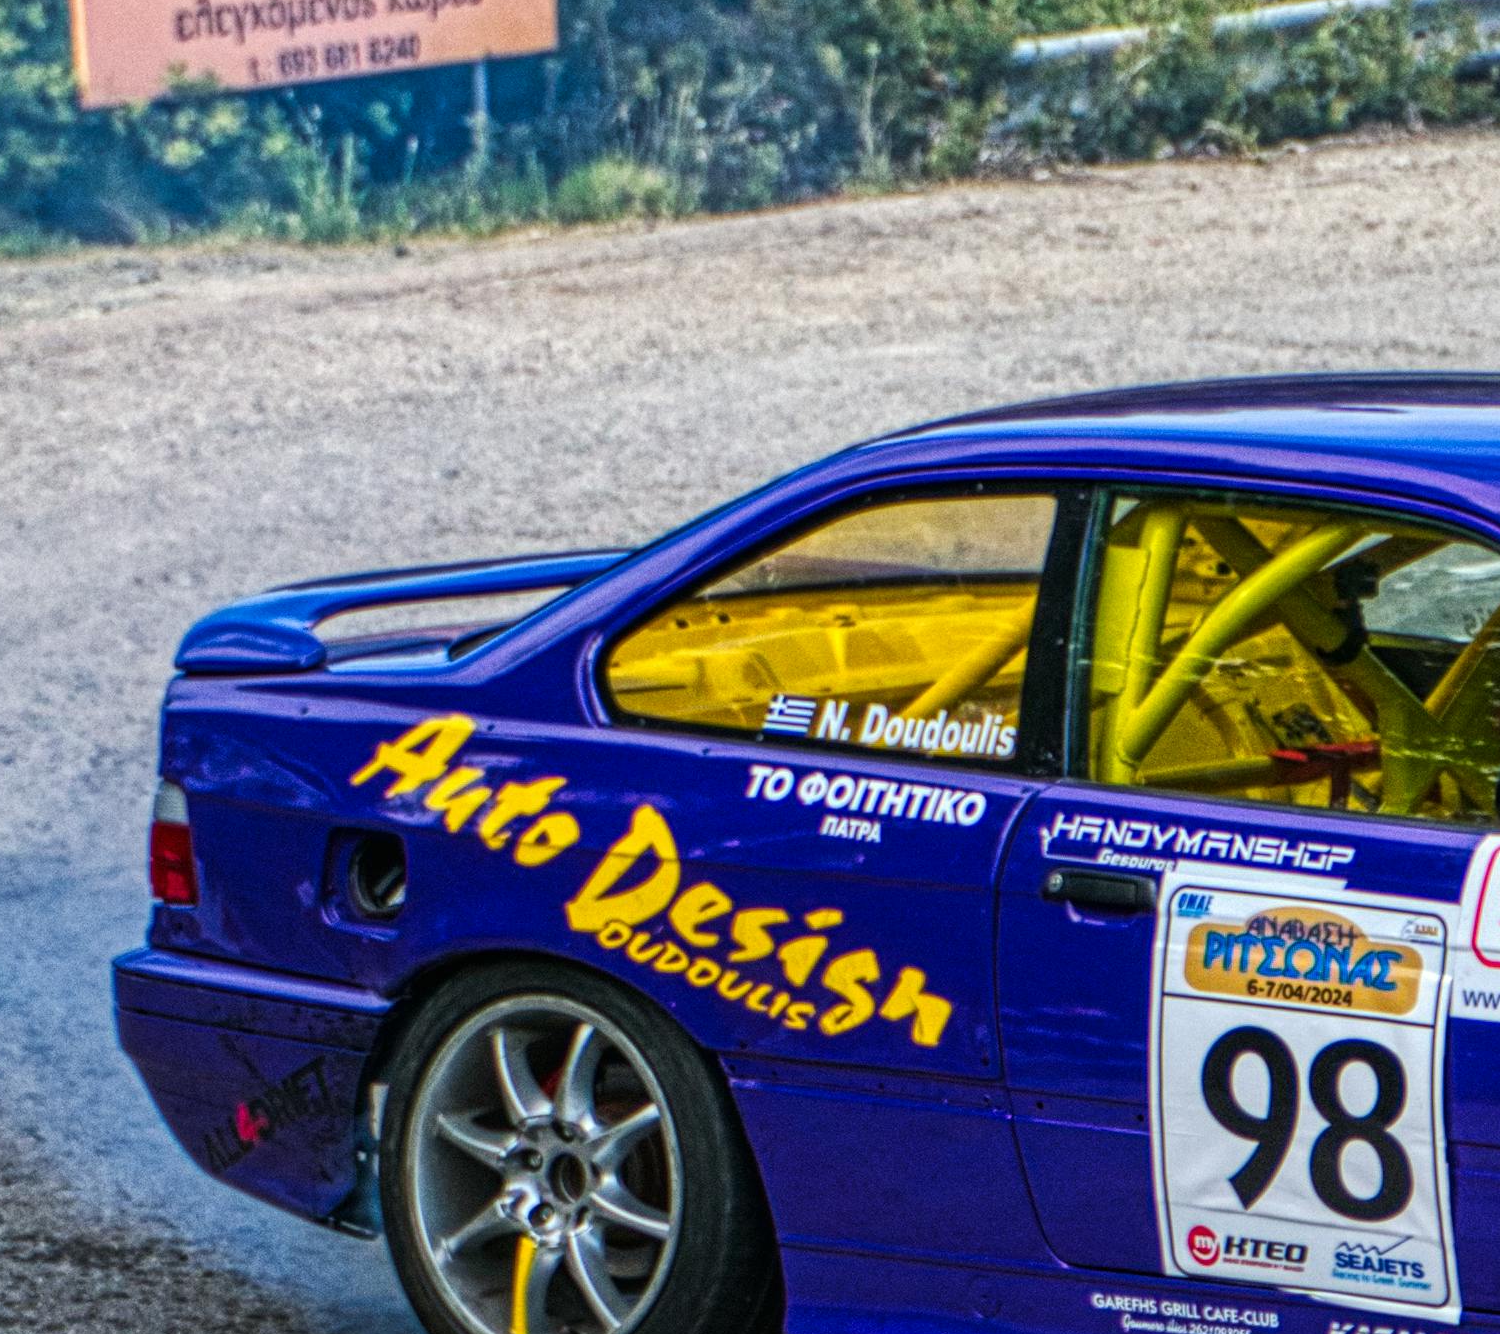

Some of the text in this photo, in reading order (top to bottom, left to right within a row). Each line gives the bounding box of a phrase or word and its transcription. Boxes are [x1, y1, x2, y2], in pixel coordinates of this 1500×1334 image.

[816, 699, 1017, 758] N. Doudoulis
[746, 764, 987, 826] ΤΟ ΦΟΙΤΗΤΙΚΟ
[820, 814, 883, 844] ΠΑΤΡΑ
[1051, 811, 1355, 871] HANDYMANSHOP
[350, 713, 953, 1049] Auto Design
[1246, 914, 1359, 945] ΑΝΑΒΑΣΗ
[1204, 929, 1402, 990] ΡΙΤΣΩΝΑΣ
[1247, 977, 1353, 1008] 6-7/04/2024
[1201, 1026, 1415, 1222] 98
[1334, 1251, 1425, 1279] SEAJETS
[1092, 1294, 1280, 1328] GAREFHS GRILL CAFE-CLUB
